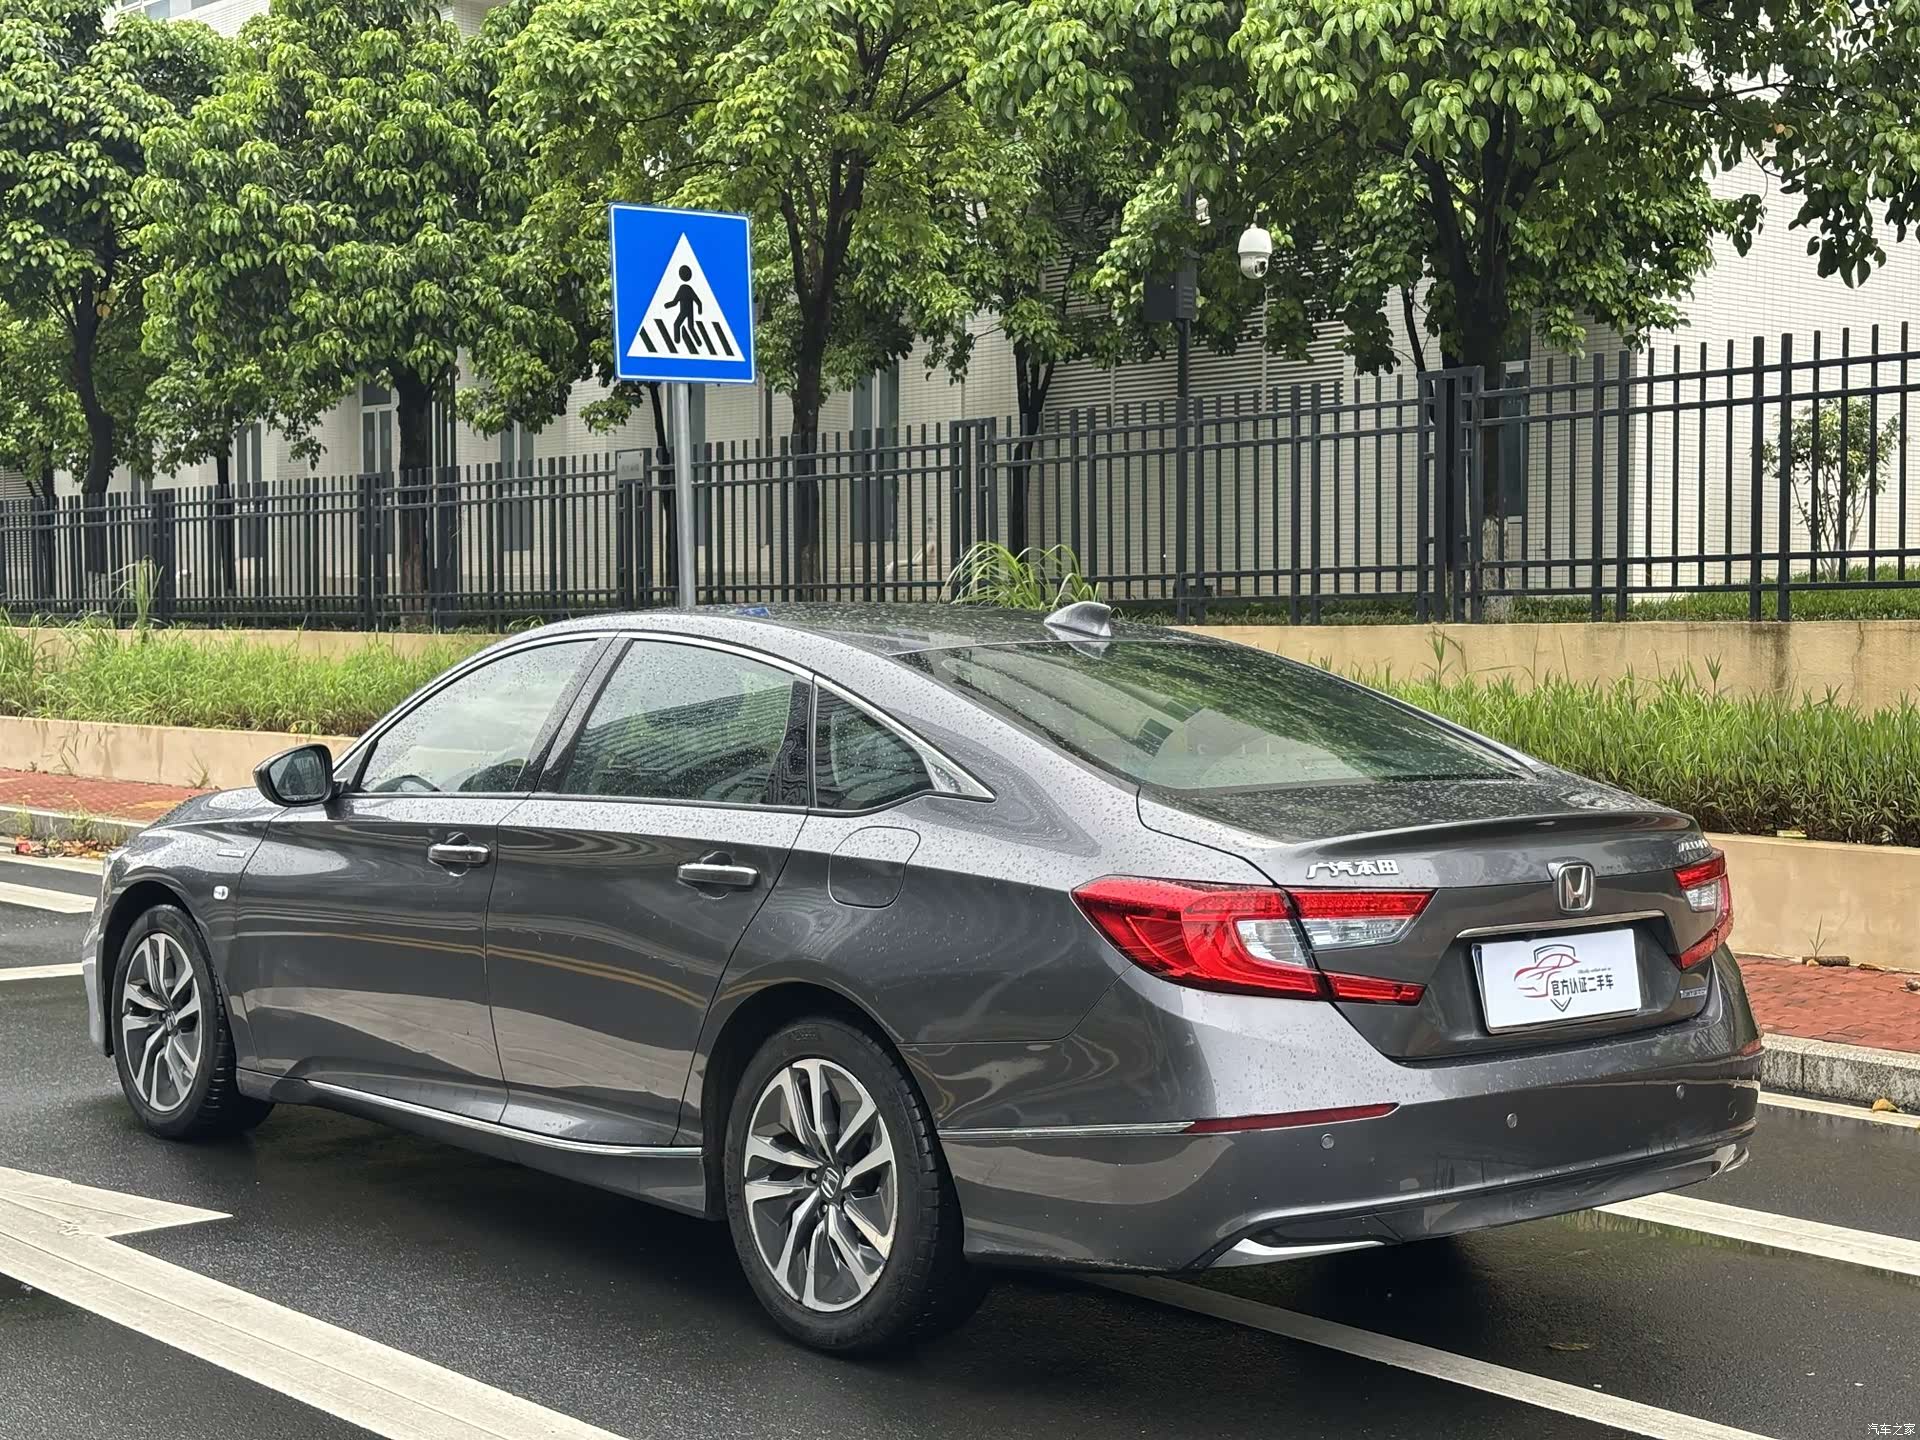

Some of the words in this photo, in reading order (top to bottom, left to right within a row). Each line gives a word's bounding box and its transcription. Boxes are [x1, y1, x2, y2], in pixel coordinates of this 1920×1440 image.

[1306, 859, 1399, 879] 广汽本田
[1551, 974, 1614, 996] 官方认证二手车
